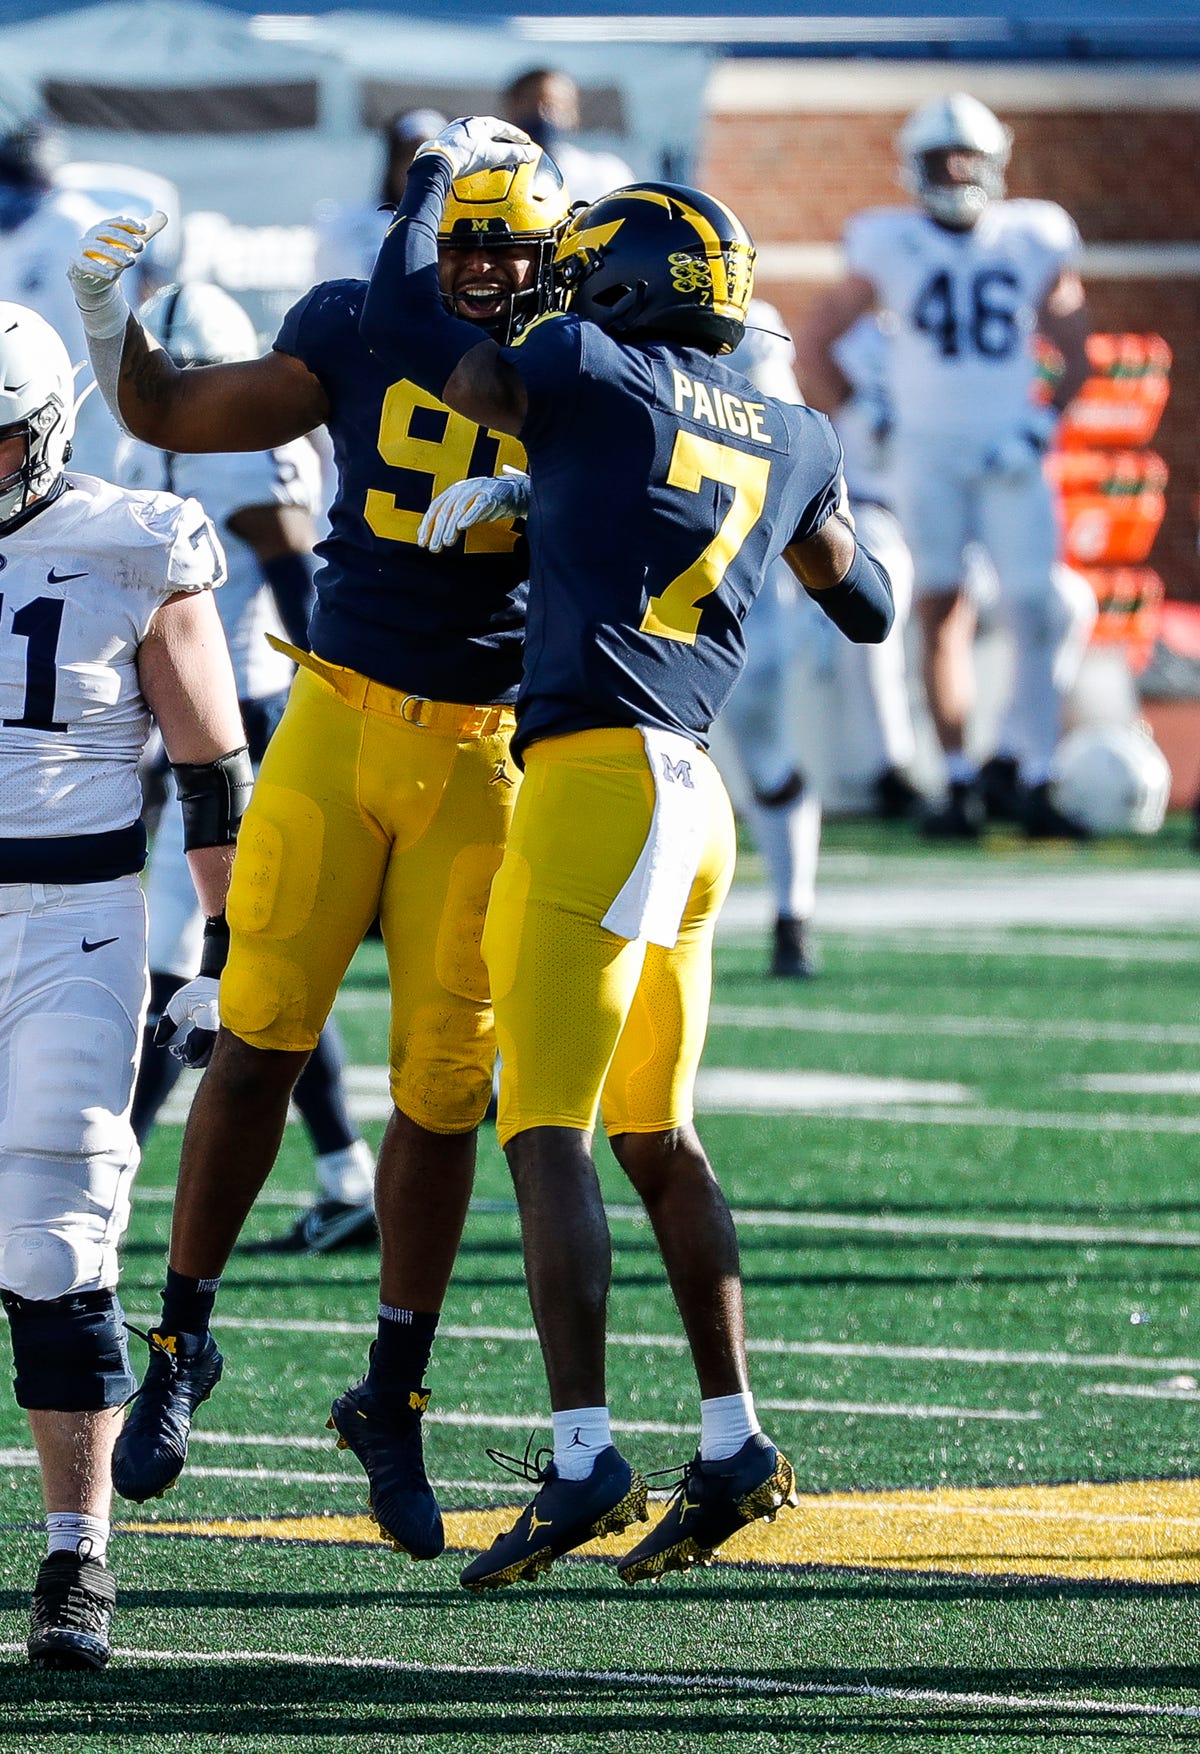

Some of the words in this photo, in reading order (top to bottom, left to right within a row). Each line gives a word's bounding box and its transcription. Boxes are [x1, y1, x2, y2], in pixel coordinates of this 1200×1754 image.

[471, 219, 489, 232] M
[700, 291, 710, 306] 7
[912, 267, 1019, 360] 46
[673, 369, 772, 445] PAIGE
[639, 429, 772, 646] 7
[660, 753, 694, 788] M
[152, 1333, 177, 1353] M
[408, 1391, 430, 1411] M
